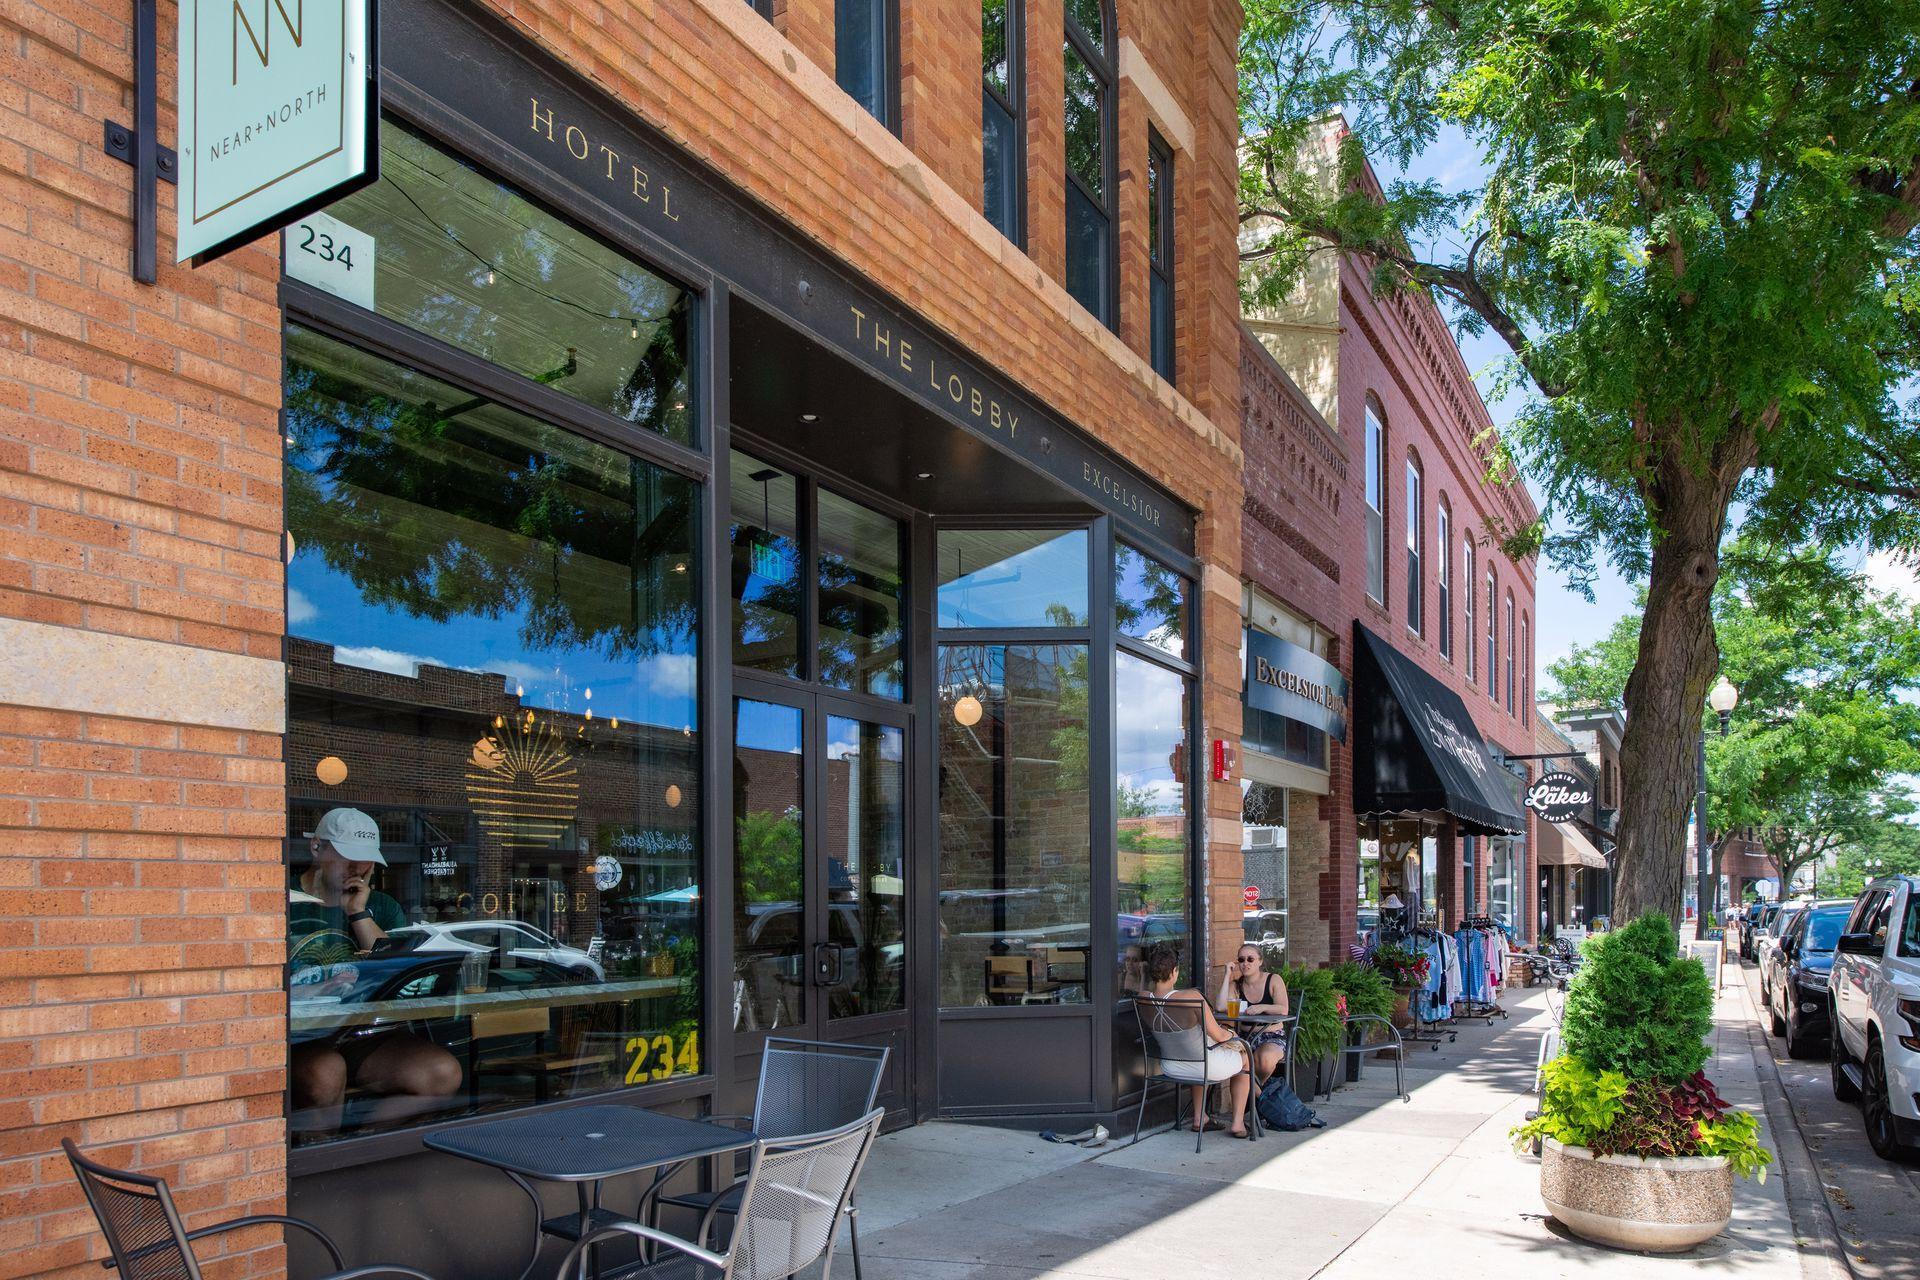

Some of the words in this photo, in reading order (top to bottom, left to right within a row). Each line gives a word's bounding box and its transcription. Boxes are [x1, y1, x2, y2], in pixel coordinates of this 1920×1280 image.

[211, 84, 326, 161] NEAR+NORTH
[531, 98, 679, 221] HOTEL
[300, 224, 353, 271] 234
[851, 306, 912, 372] THE
[931, 360, 1018, 438] LOBBY
[1083, 461, 1160, 527] EXCELSIOR
[1524, 785, 1591, 810] Lakes
[1543, 774, 1576, 784] RUNNING
[1539, 811, 1575, 821] COMPANY
[456, 892, 587, 914] COFEE
[625, 1030, 698, 1085] 234
